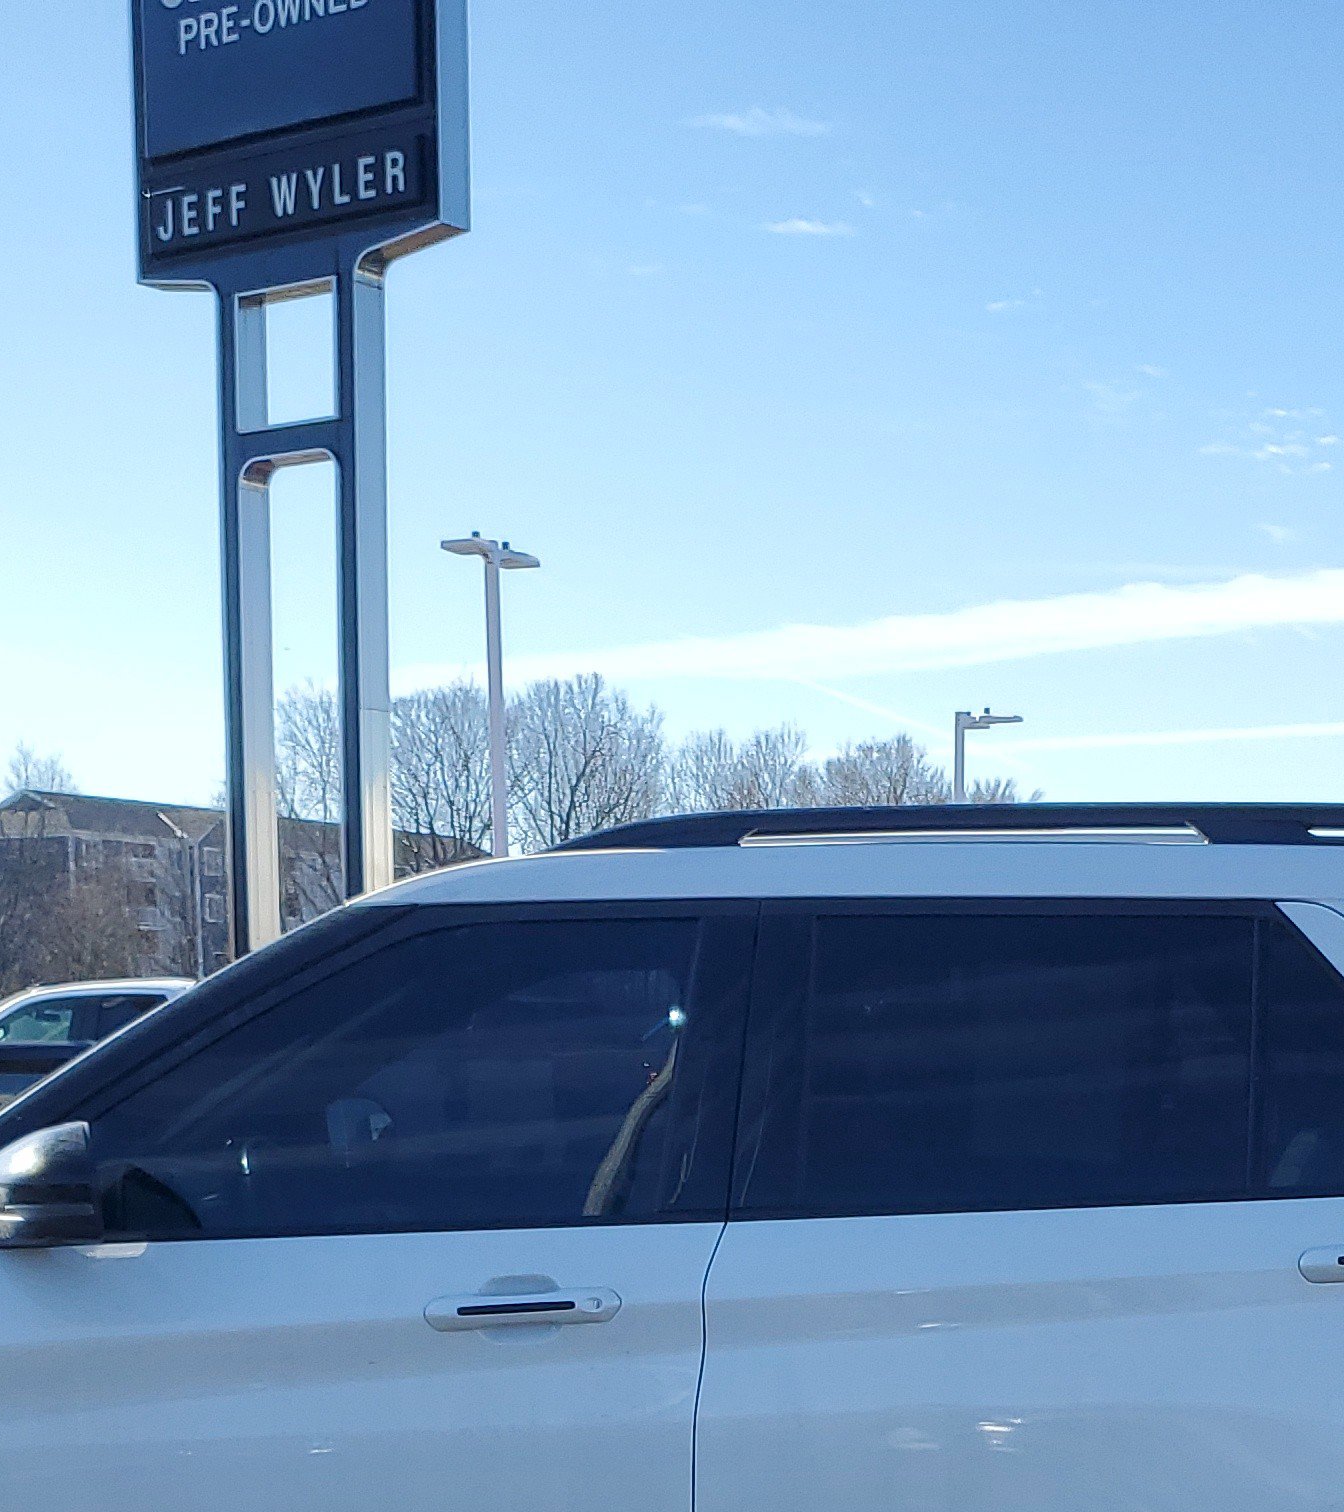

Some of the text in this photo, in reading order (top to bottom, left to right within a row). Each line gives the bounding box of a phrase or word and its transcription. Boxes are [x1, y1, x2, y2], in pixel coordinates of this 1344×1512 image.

[178, 0, 368, 54] PRE-OWN
[157, 150, 406, 241] JEFF WYLER
